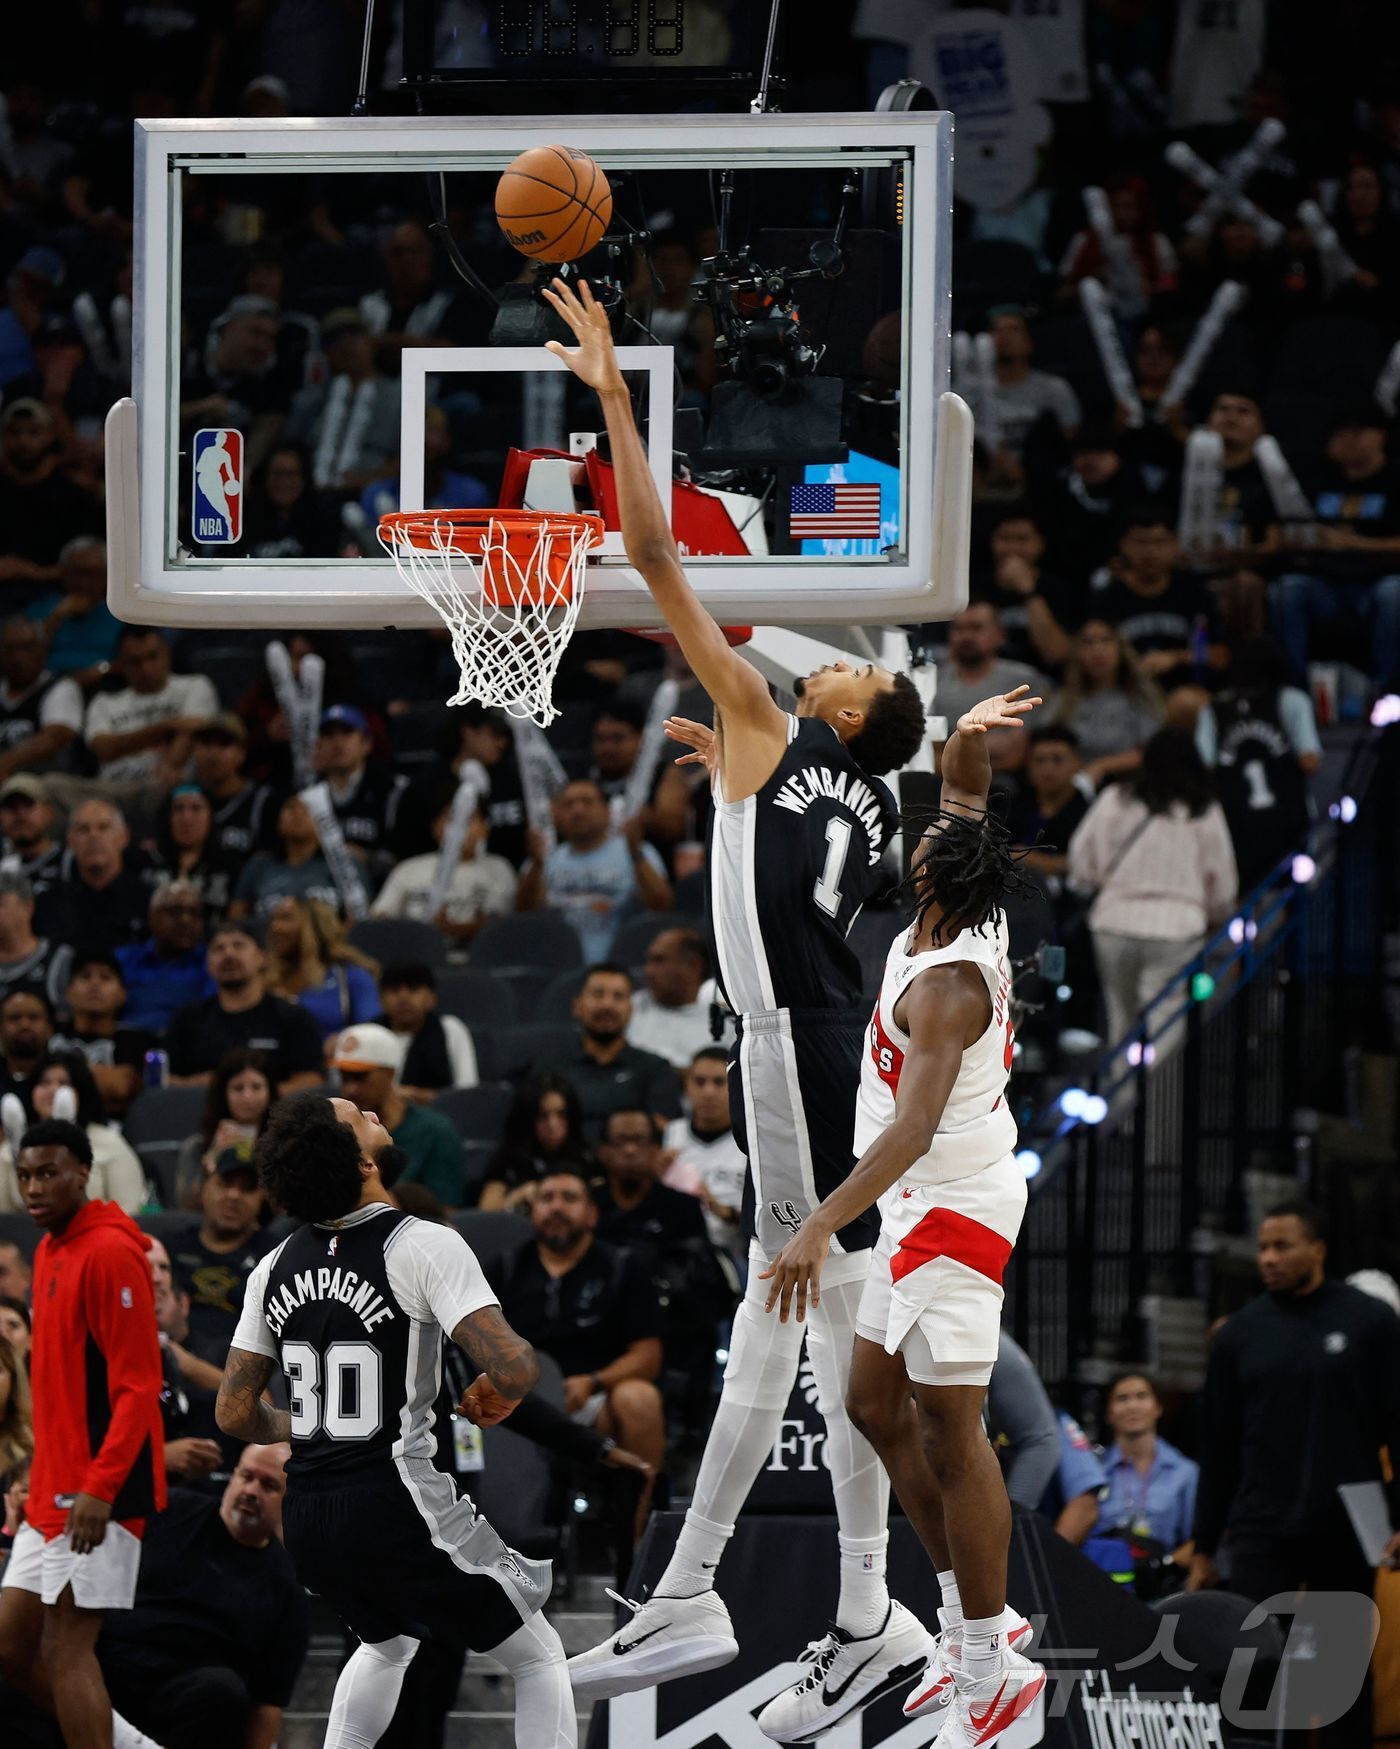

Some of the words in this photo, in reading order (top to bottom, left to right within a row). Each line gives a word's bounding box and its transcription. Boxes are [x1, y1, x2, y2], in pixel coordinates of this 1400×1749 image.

[200, 518, 222, 536] NBA
[772, 766, 884, 867] WEMBANYAMA
[813, 815, 853, 919] 1
[265, 1267, 395, 1338] CHAMPAGNIE
[281, 1340, 384, 1442] 30
